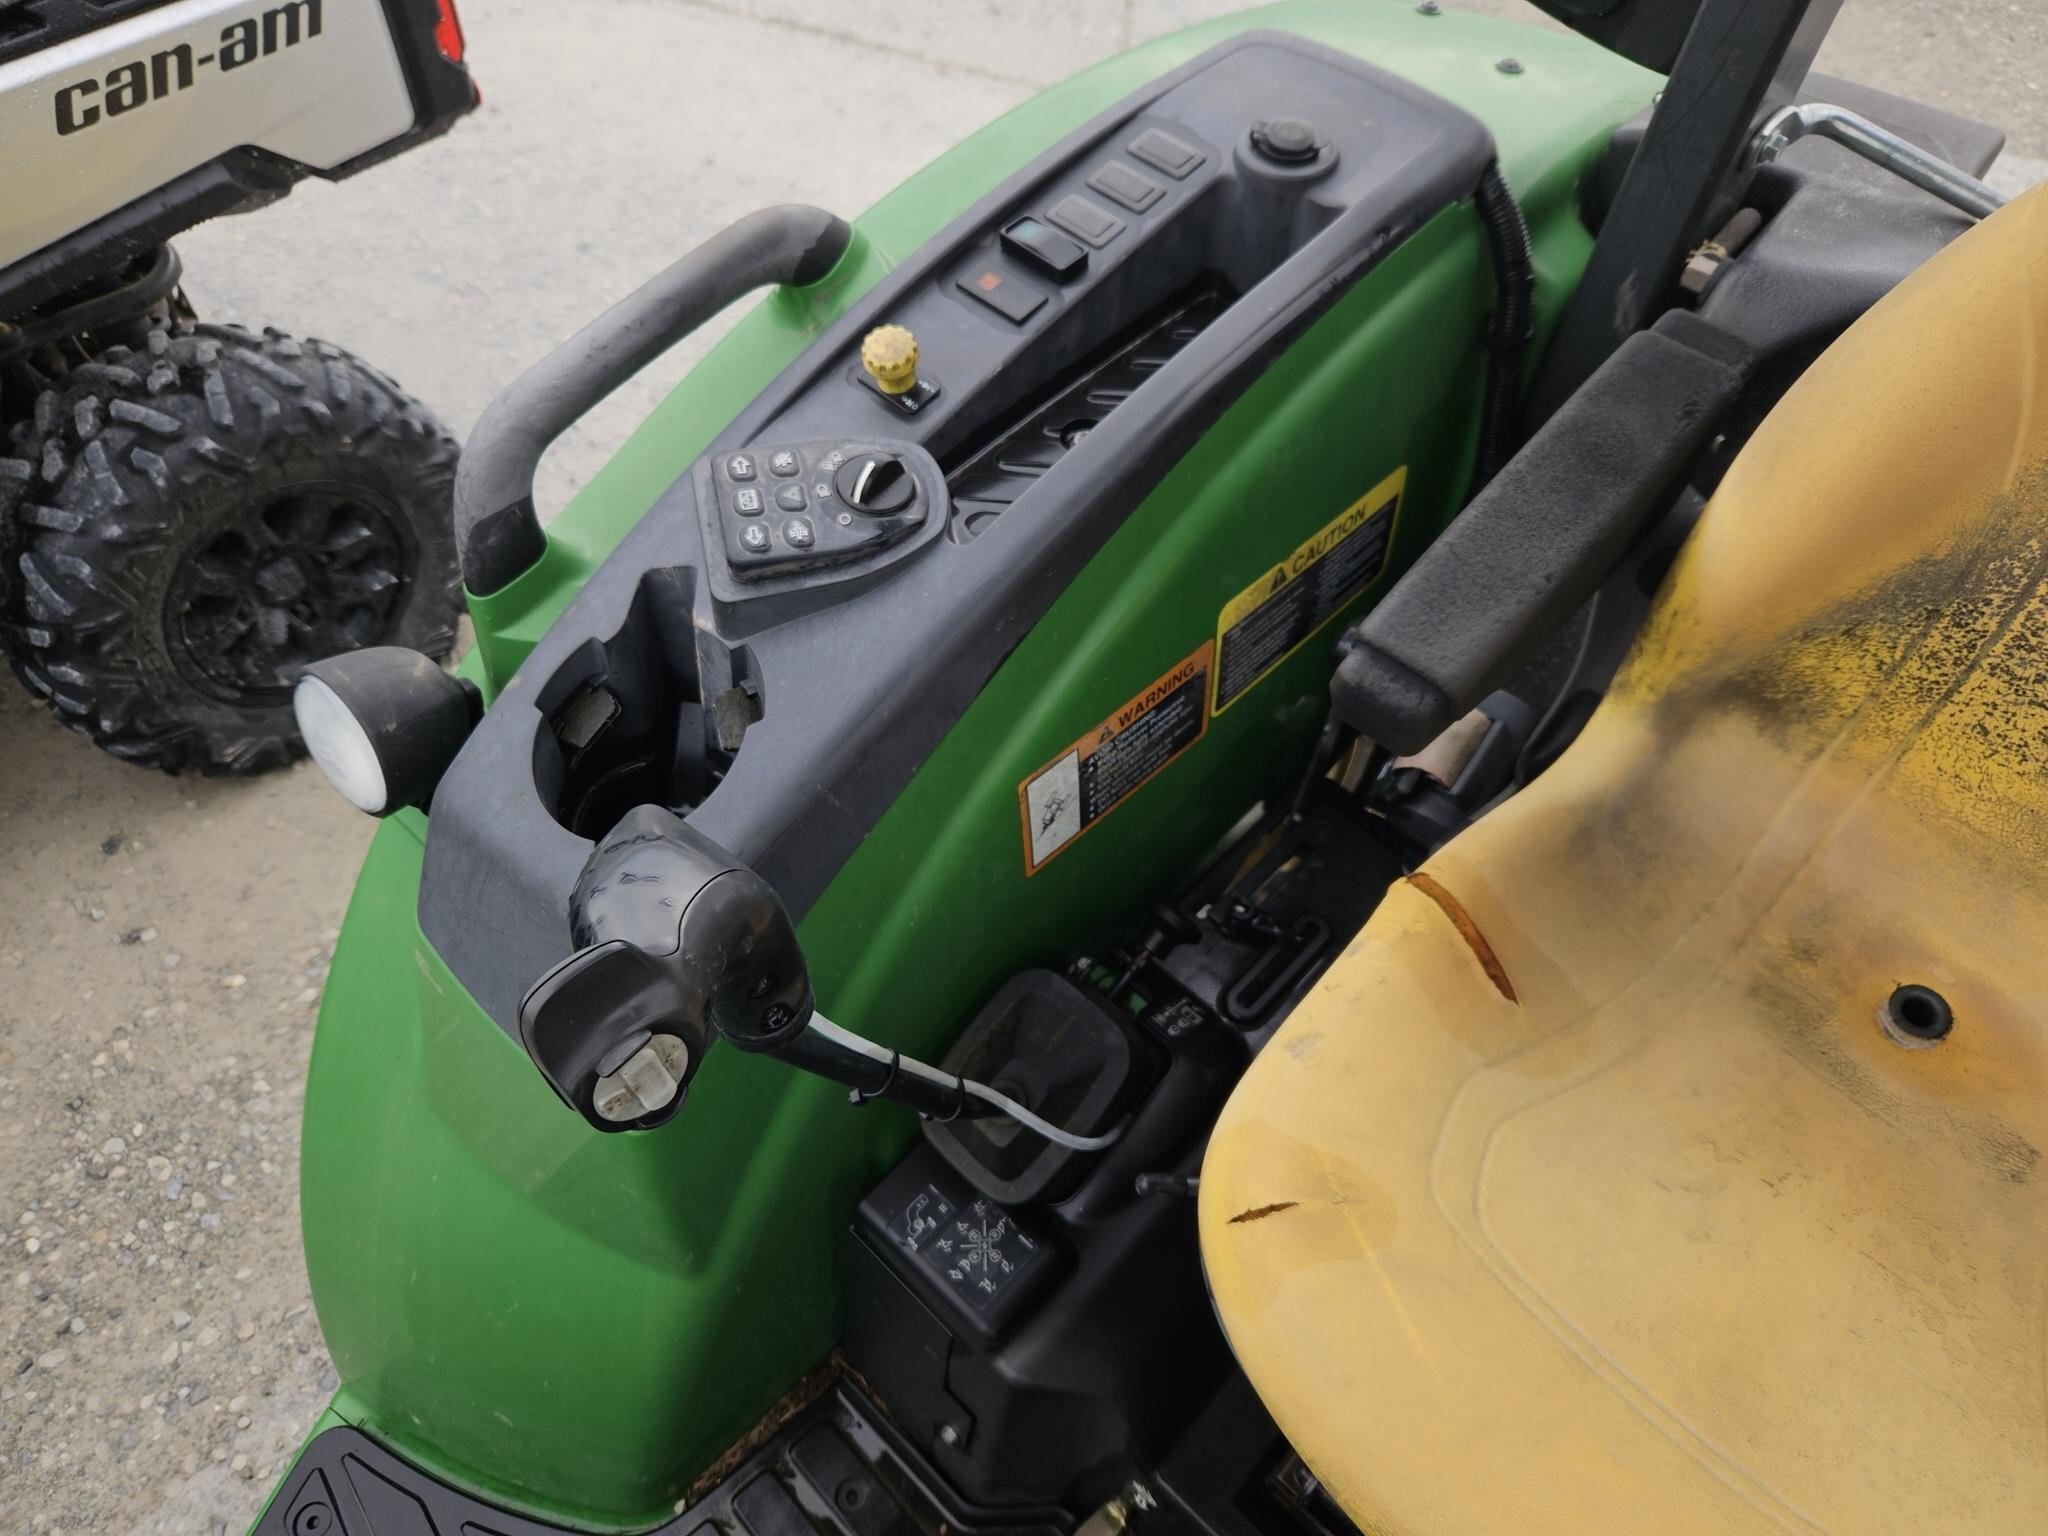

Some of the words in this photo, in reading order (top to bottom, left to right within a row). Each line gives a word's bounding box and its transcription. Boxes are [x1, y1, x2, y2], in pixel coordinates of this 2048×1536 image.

[55, 0, 321, 136] can-am
[1291, 503, 1367, 575] CAUTION
[1118, 662, 1195, 728] WARNING
